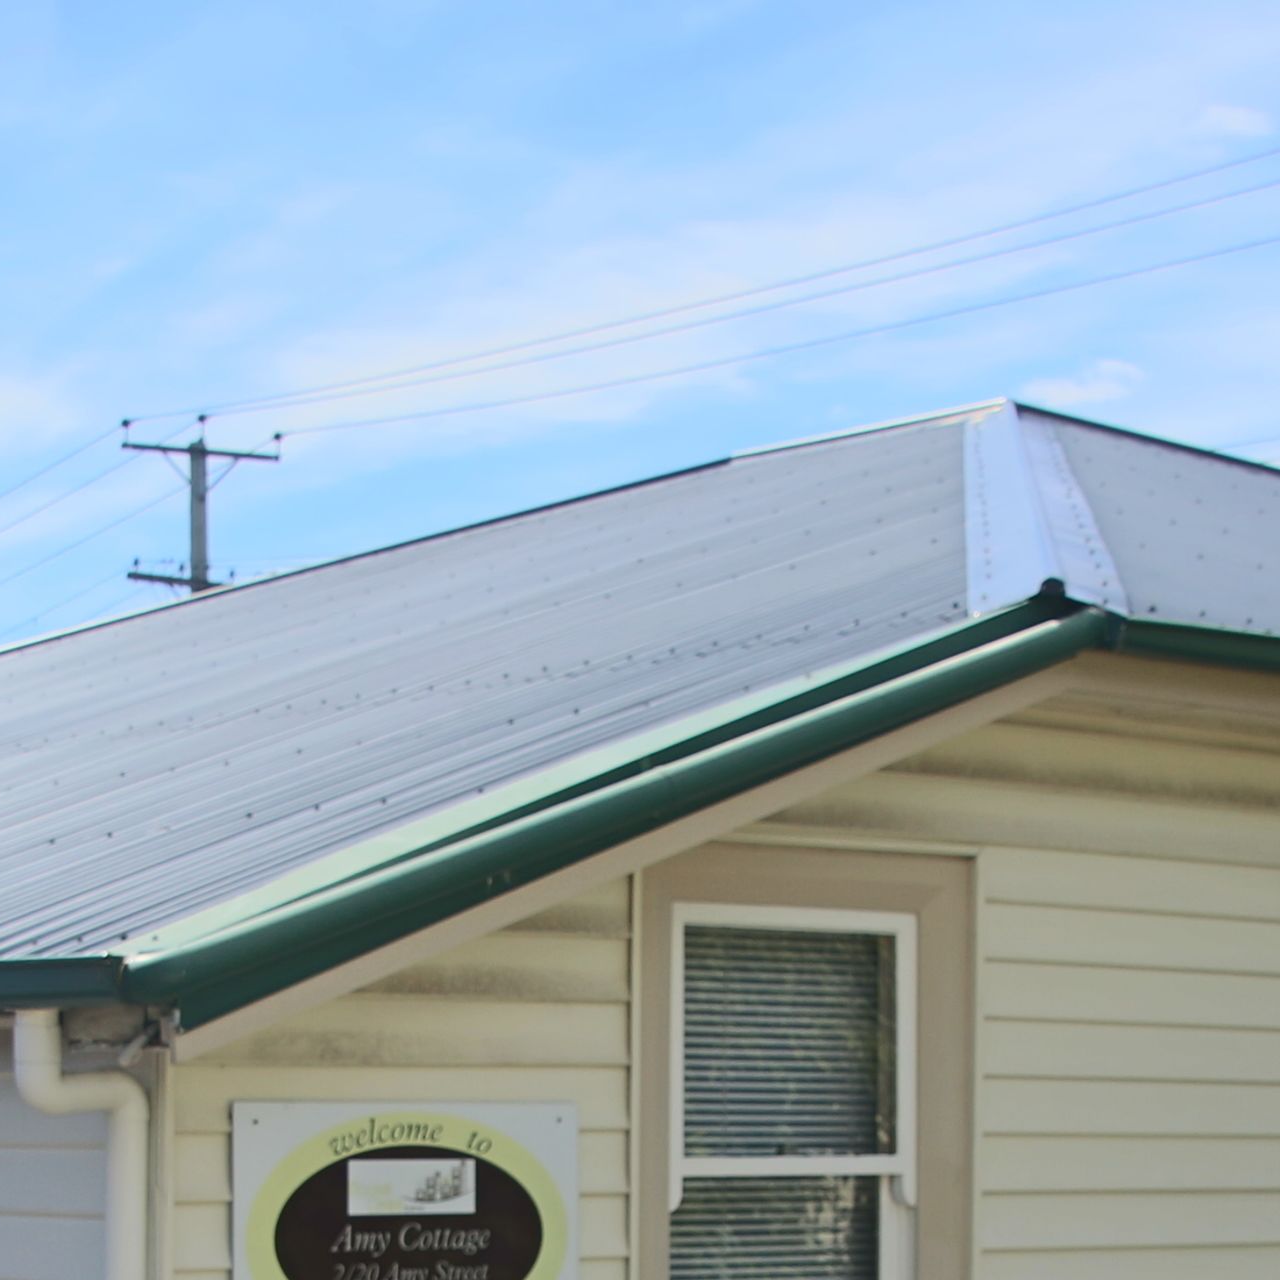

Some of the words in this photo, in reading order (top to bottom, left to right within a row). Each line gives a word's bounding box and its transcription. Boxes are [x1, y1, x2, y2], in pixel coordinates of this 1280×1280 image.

[329, 1117, 444, 1156] welcome
[466, 1131, 493, 1155] to
[330, 1224, 392, 1257] Amy
[398, 1221, 491, 1256] Cottage
